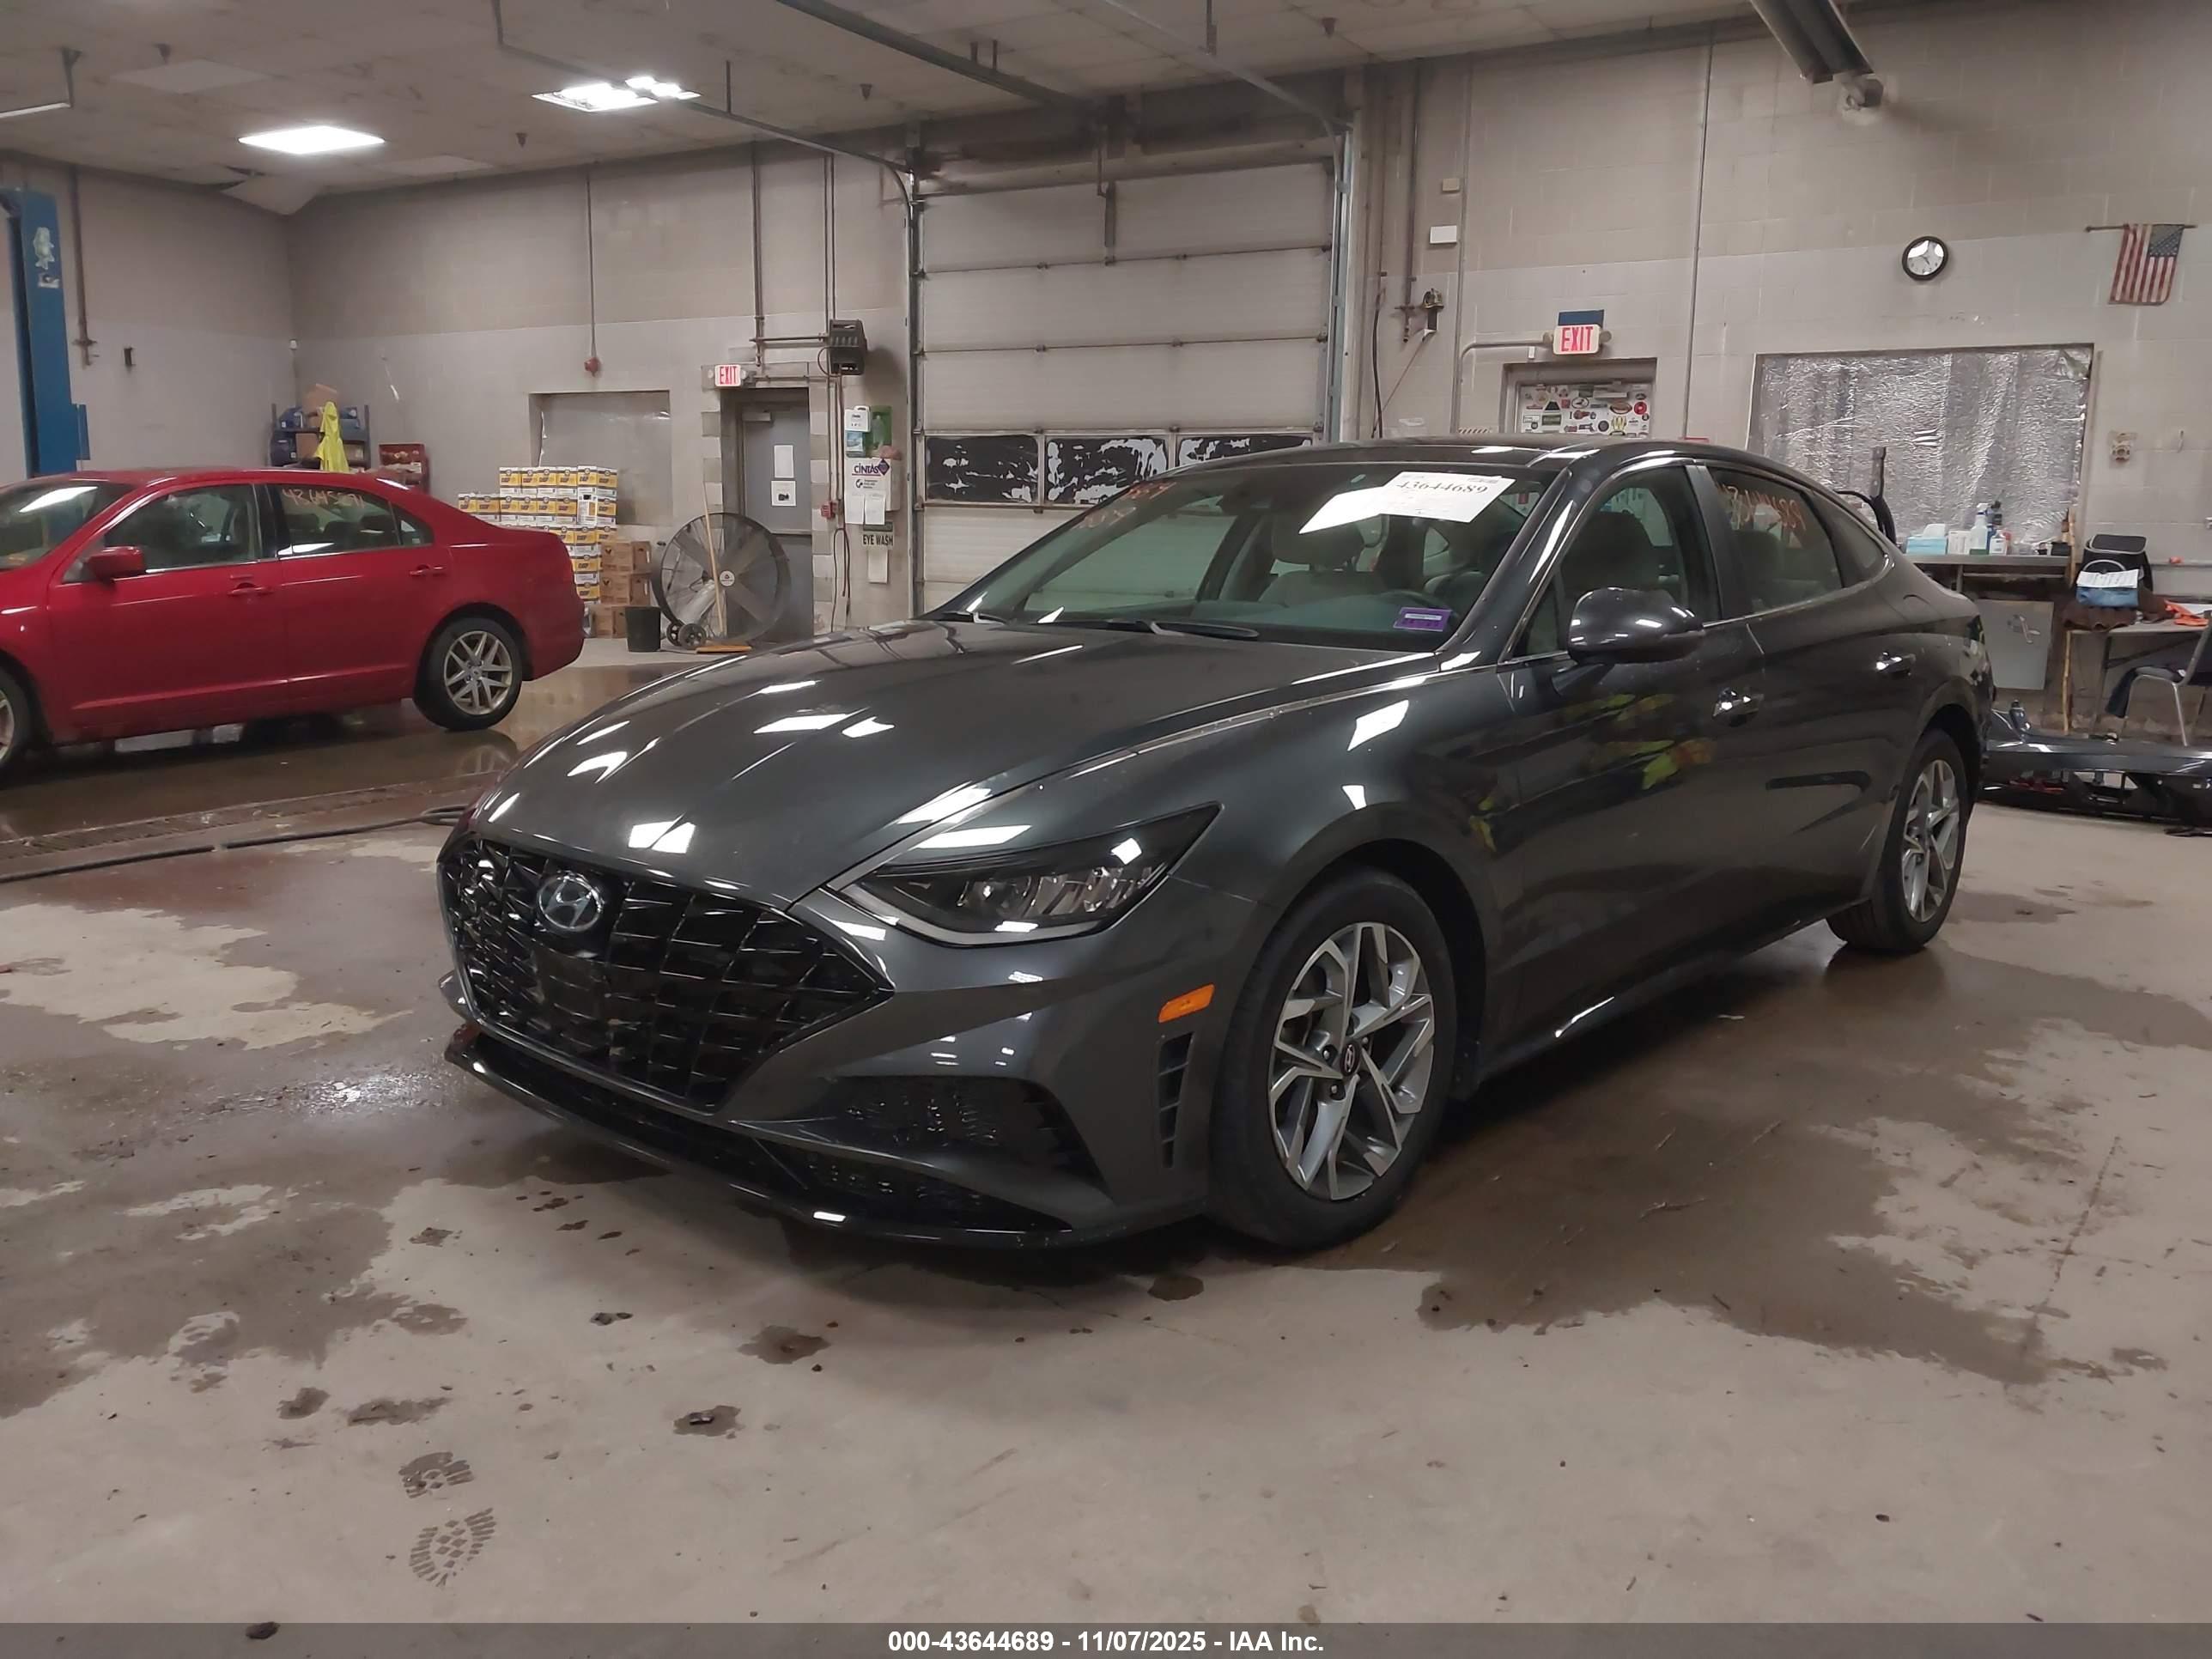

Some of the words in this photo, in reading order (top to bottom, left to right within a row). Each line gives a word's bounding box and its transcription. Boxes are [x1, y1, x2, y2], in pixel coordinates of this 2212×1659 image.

[1561, 326, 1594, 351] EXIT
[720, 366, 738, 385] EXIT
[863, 534, 874, 545] EYE
[876, 534, 893, 546] WASH
